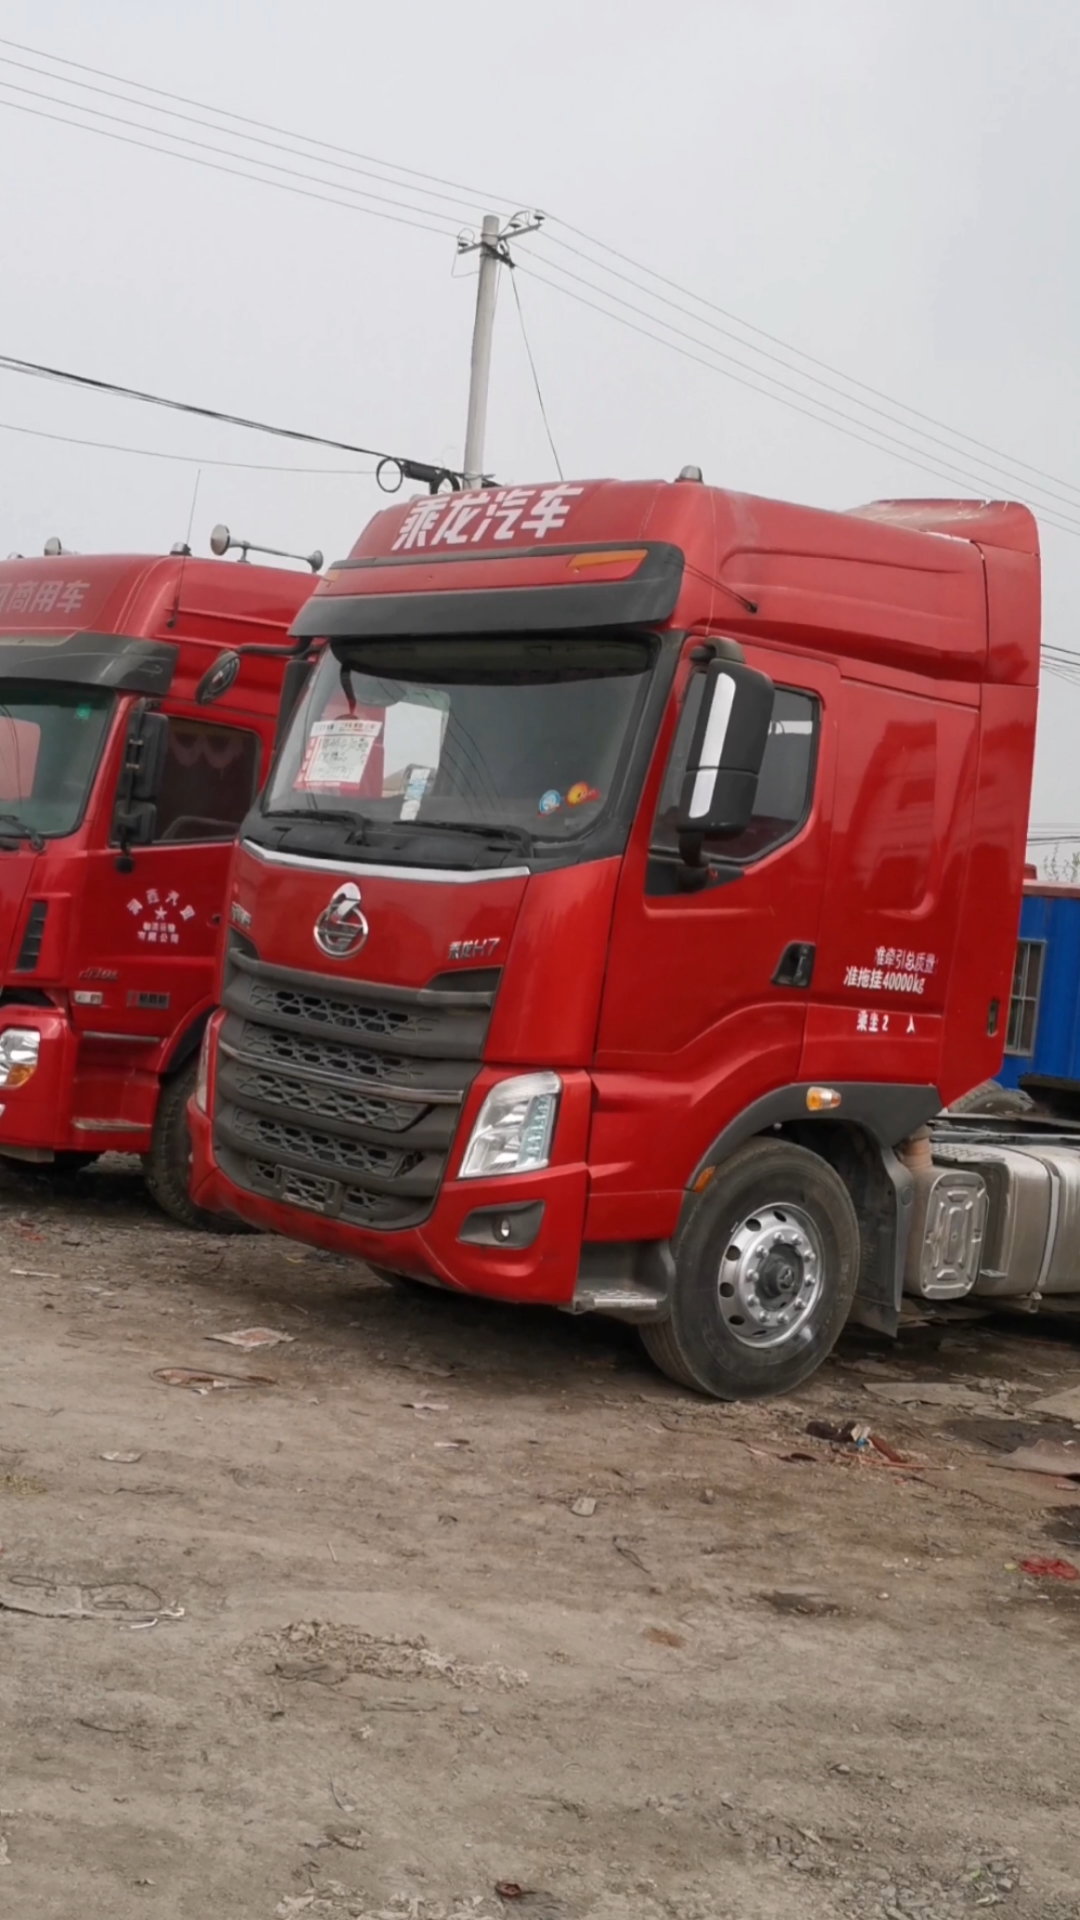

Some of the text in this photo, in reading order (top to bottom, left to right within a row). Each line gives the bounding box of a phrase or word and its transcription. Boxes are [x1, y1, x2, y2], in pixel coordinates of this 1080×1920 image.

[391, 485, 584, 551] 乘龙汽车
[843, 966, 926, 994] 准拖挂40000kg
